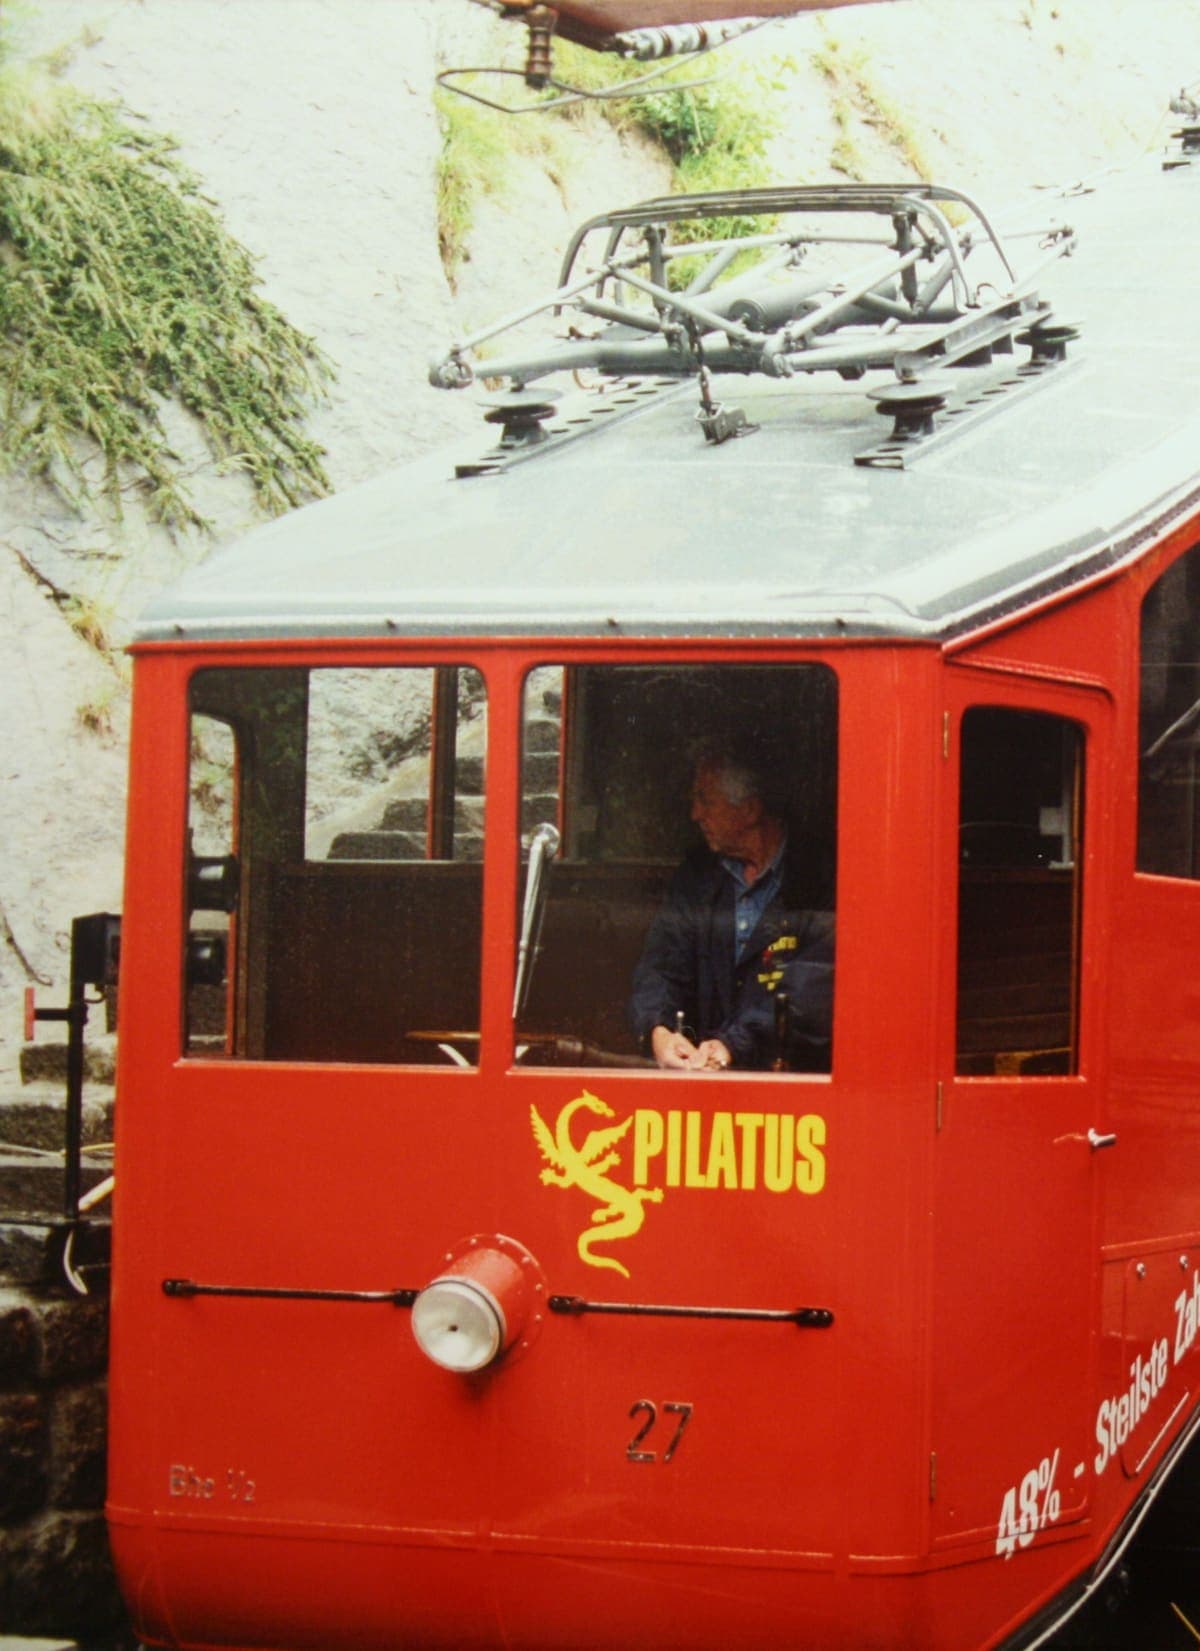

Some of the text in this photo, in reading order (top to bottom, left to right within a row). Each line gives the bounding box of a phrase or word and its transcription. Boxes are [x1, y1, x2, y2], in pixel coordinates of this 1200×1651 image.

[635, 1109, 827, 1195] PILATUS
[627, 1399, 693, 1462] 27
[995, 1447, 1061, 1561] 48%
[1094, 1338, 1168, 1475] Steilste
